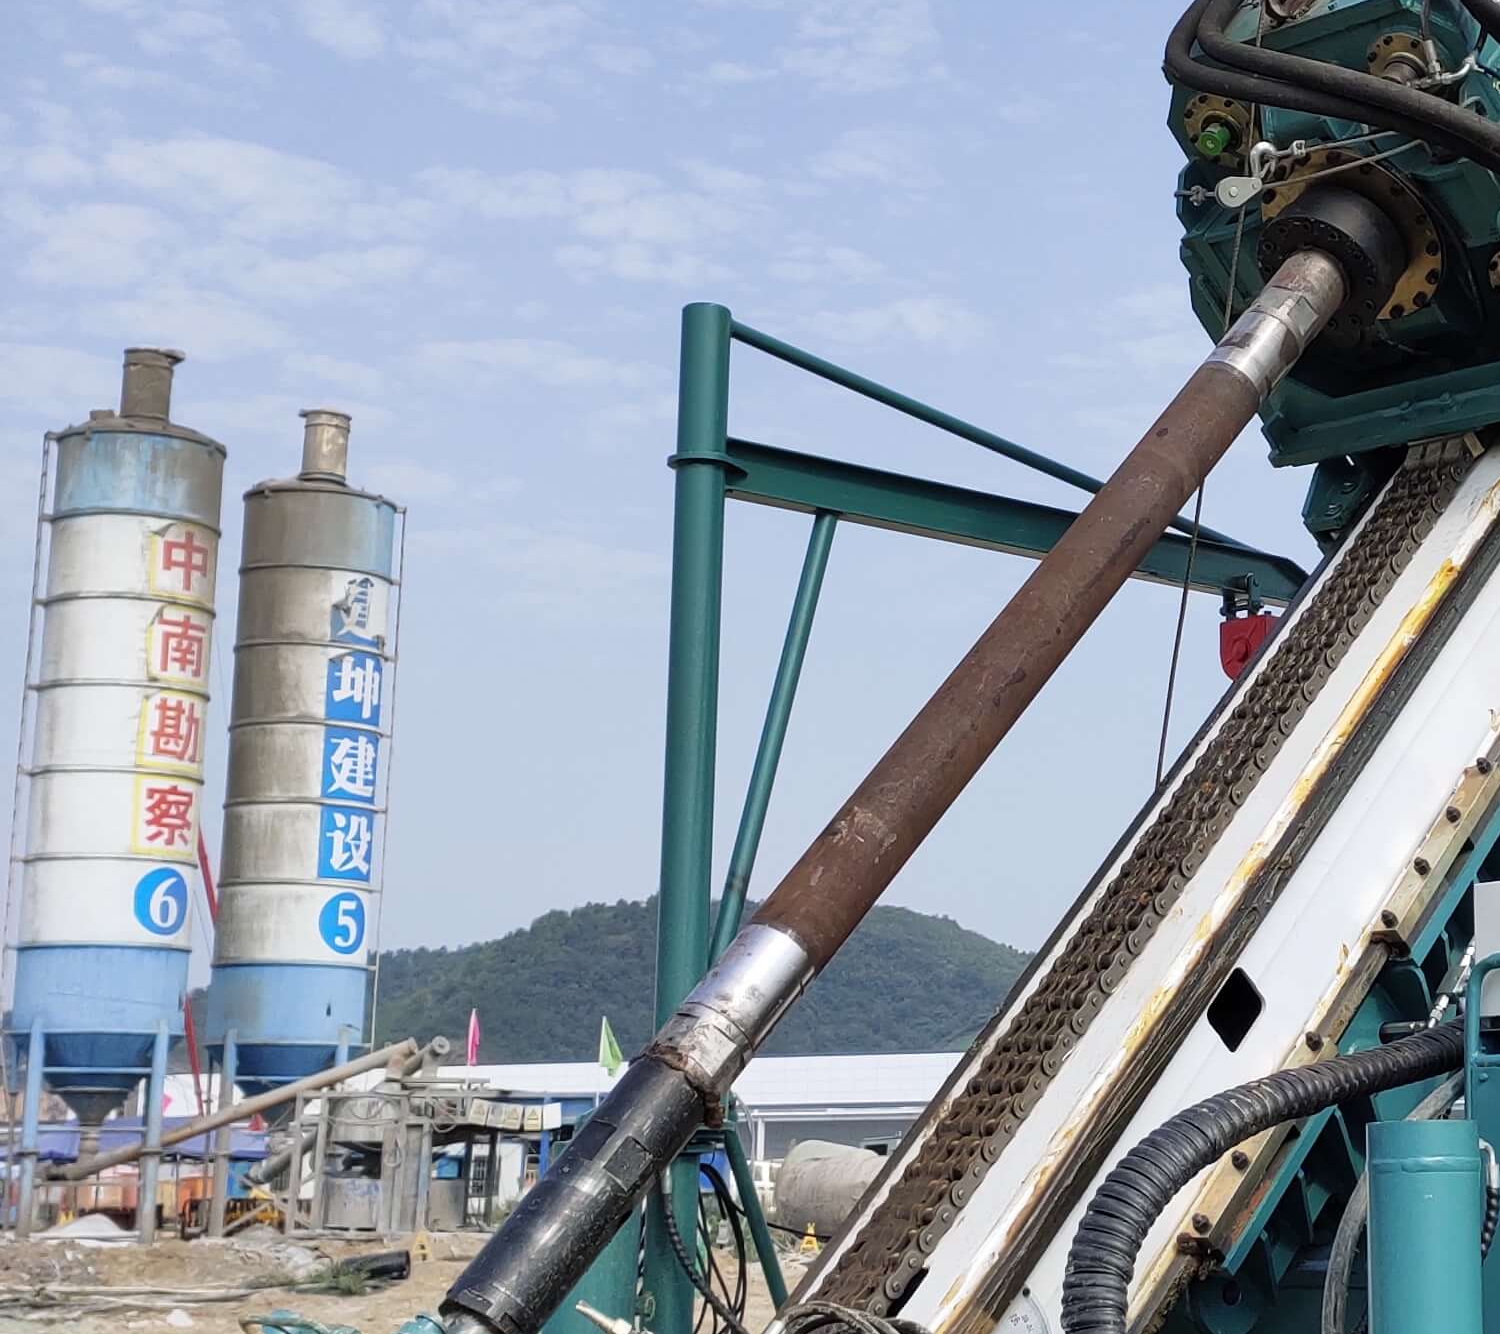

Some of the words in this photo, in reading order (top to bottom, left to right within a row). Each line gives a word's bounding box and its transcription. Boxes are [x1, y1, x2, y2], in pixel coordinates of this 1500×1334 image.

[145, 531, 208, 846] 中南勘察
[325, 576, 380, 875] 坤建设
[148, 872, 179, 929] 6
[333, 898, 358, 949] 5
